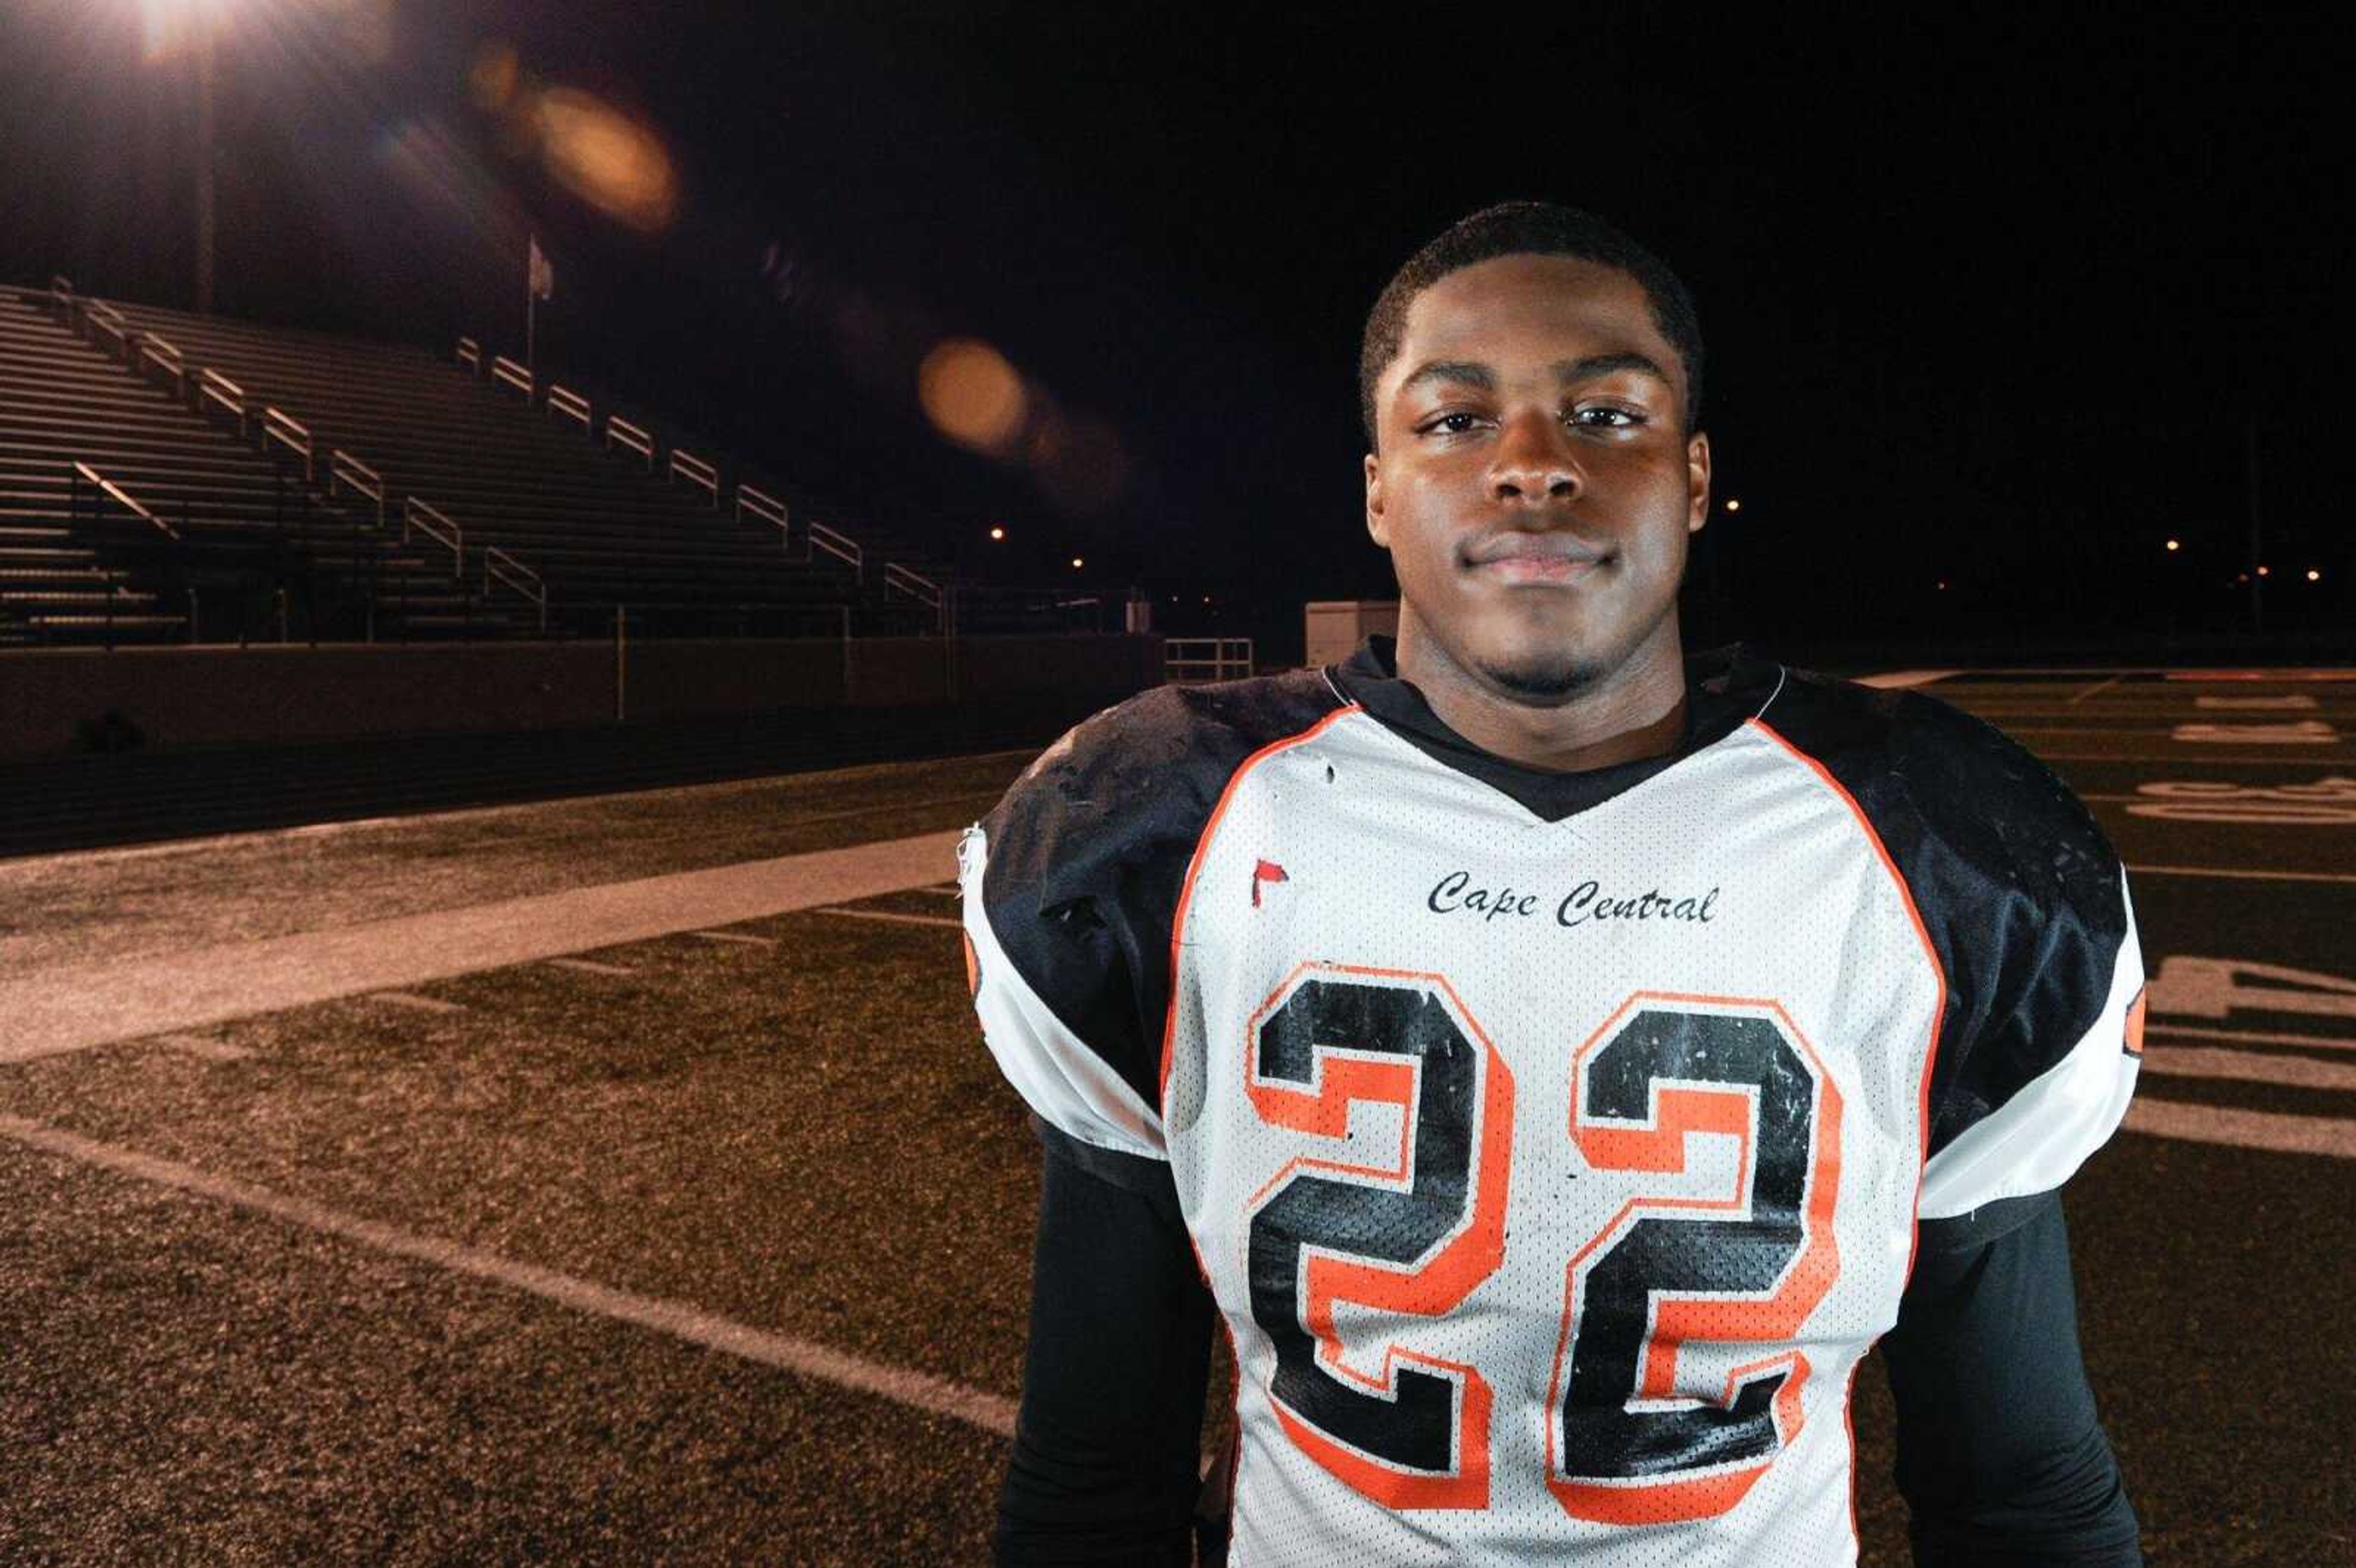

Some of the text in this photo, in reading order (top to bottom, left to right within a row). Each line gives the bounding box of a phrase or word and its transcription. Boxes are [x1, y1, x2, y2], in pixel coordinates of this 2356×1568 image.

[1427, 870, 1720, 927] Cape Central
[1244, 961, 1843, 1526] 22
